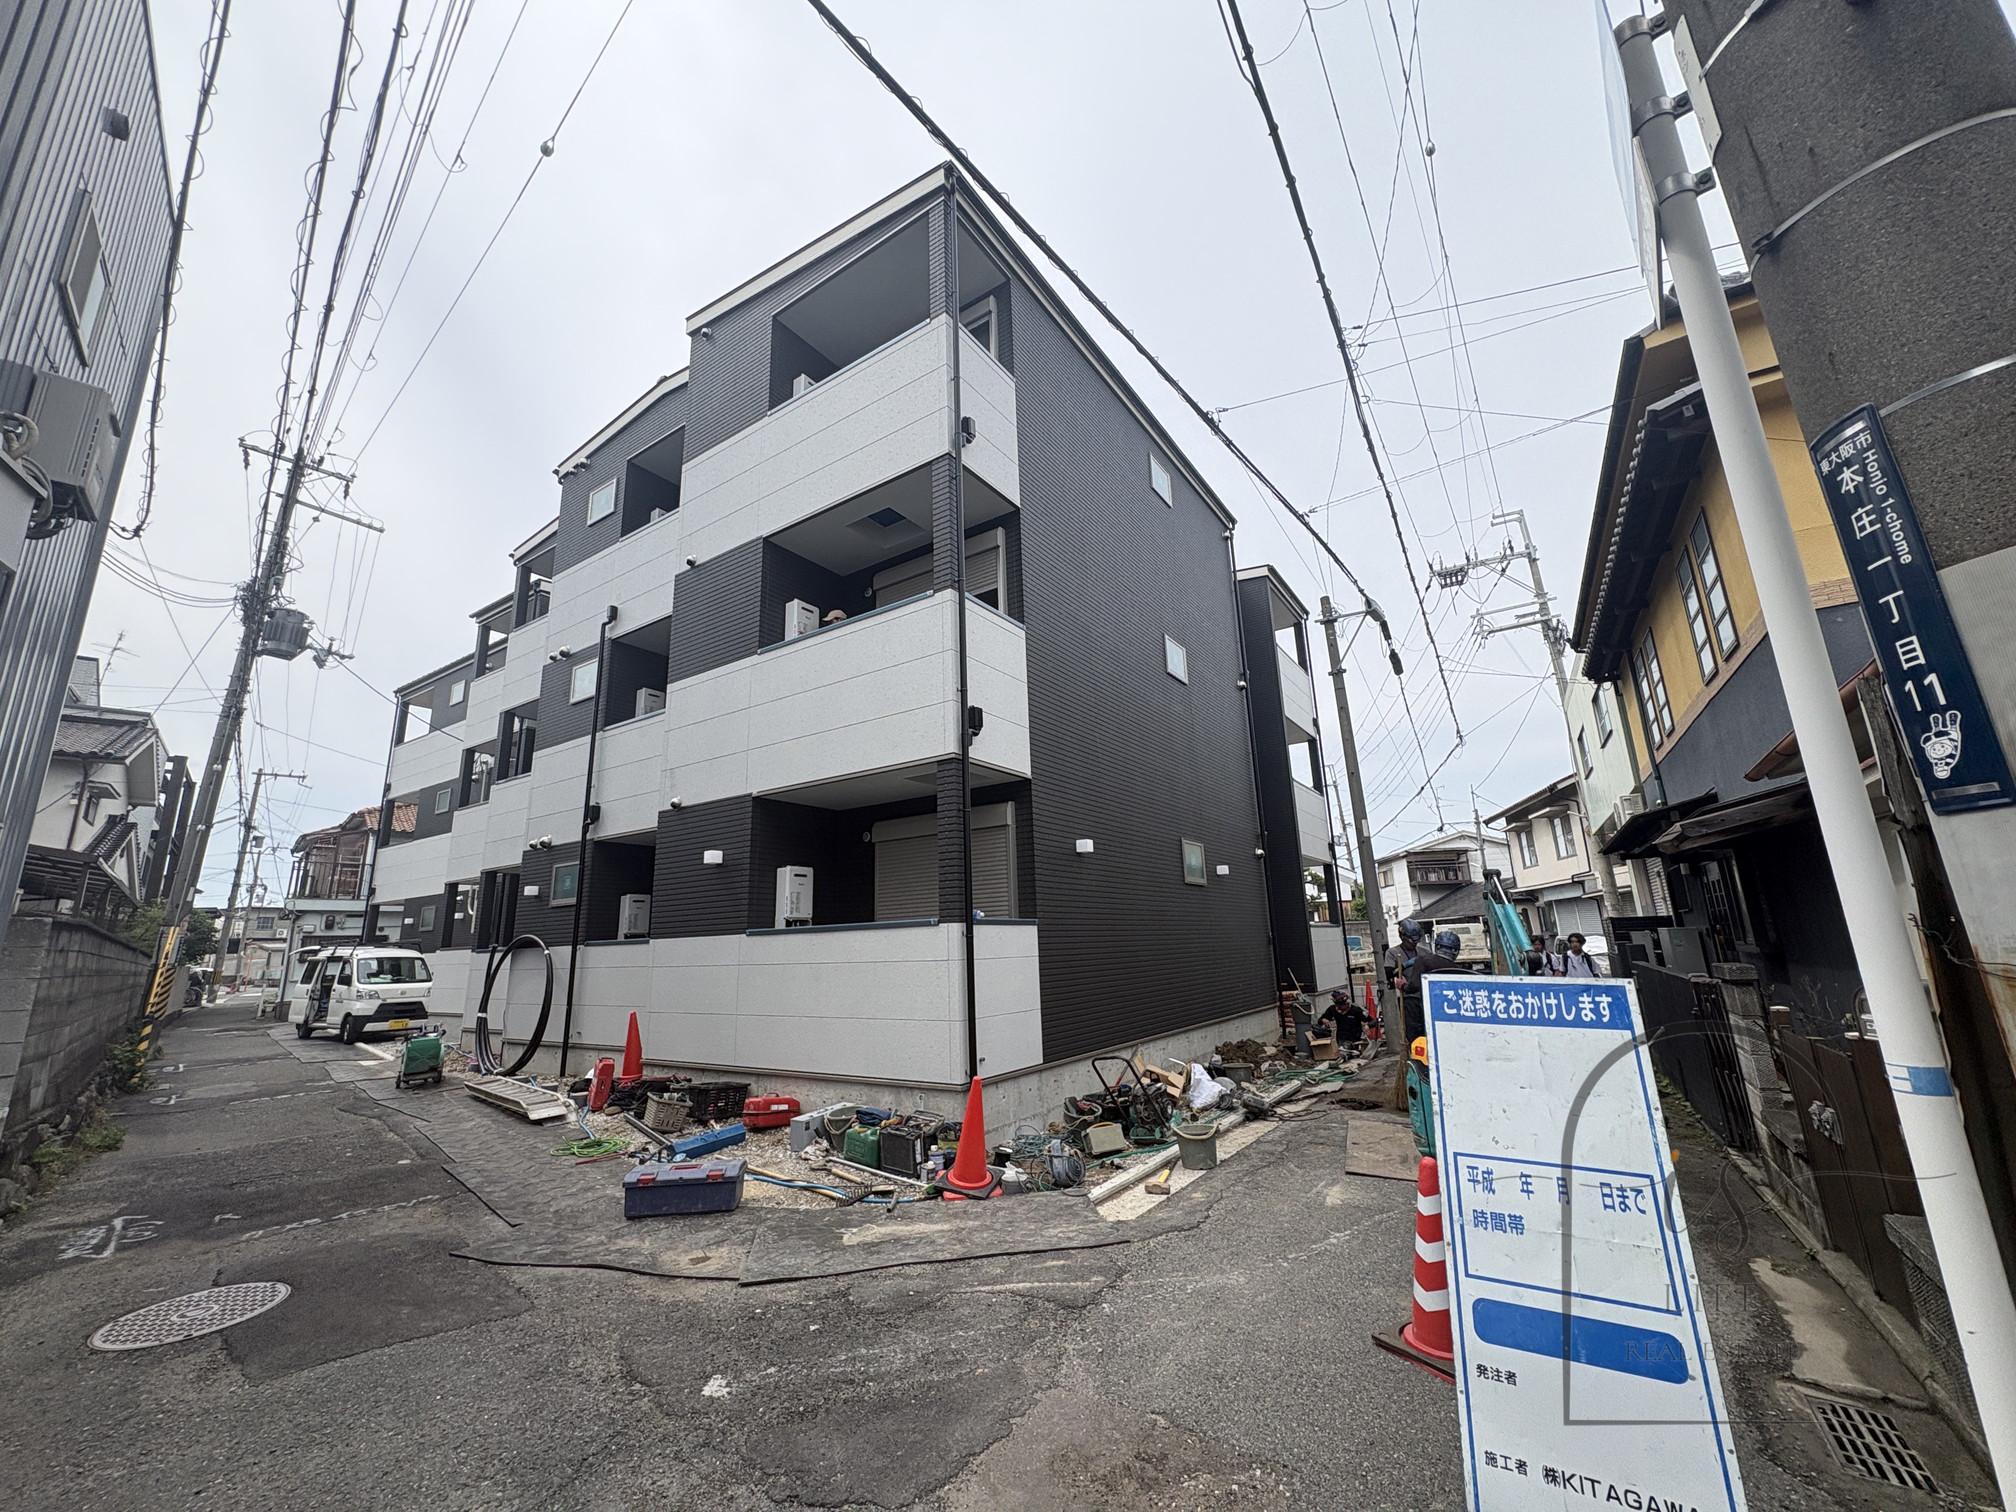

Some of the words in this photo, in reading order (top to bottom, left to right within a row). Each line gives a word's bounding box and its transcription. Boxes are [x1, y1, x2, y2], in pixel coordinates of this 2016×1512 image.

[1820, 430, 1872, 476] 東大阪市
[1863, 448, 1888, 495] Honjo
[1881, 497, 1912, 564] 1-chome
[1442, 989, 1612, 1022] ご迷惑をおかけします
[1466, 1165, 1496, 1196] 平成
[1519, 1171, 1535, 1200] 年
[1599, 1182, 1647, 1215] 日まで
[1472, 1209, 1525, 1236] 時間帯
[1475, 1363, 1518, 1386] 発注者
[1484, 1450, 1528, 1477] 施工者
